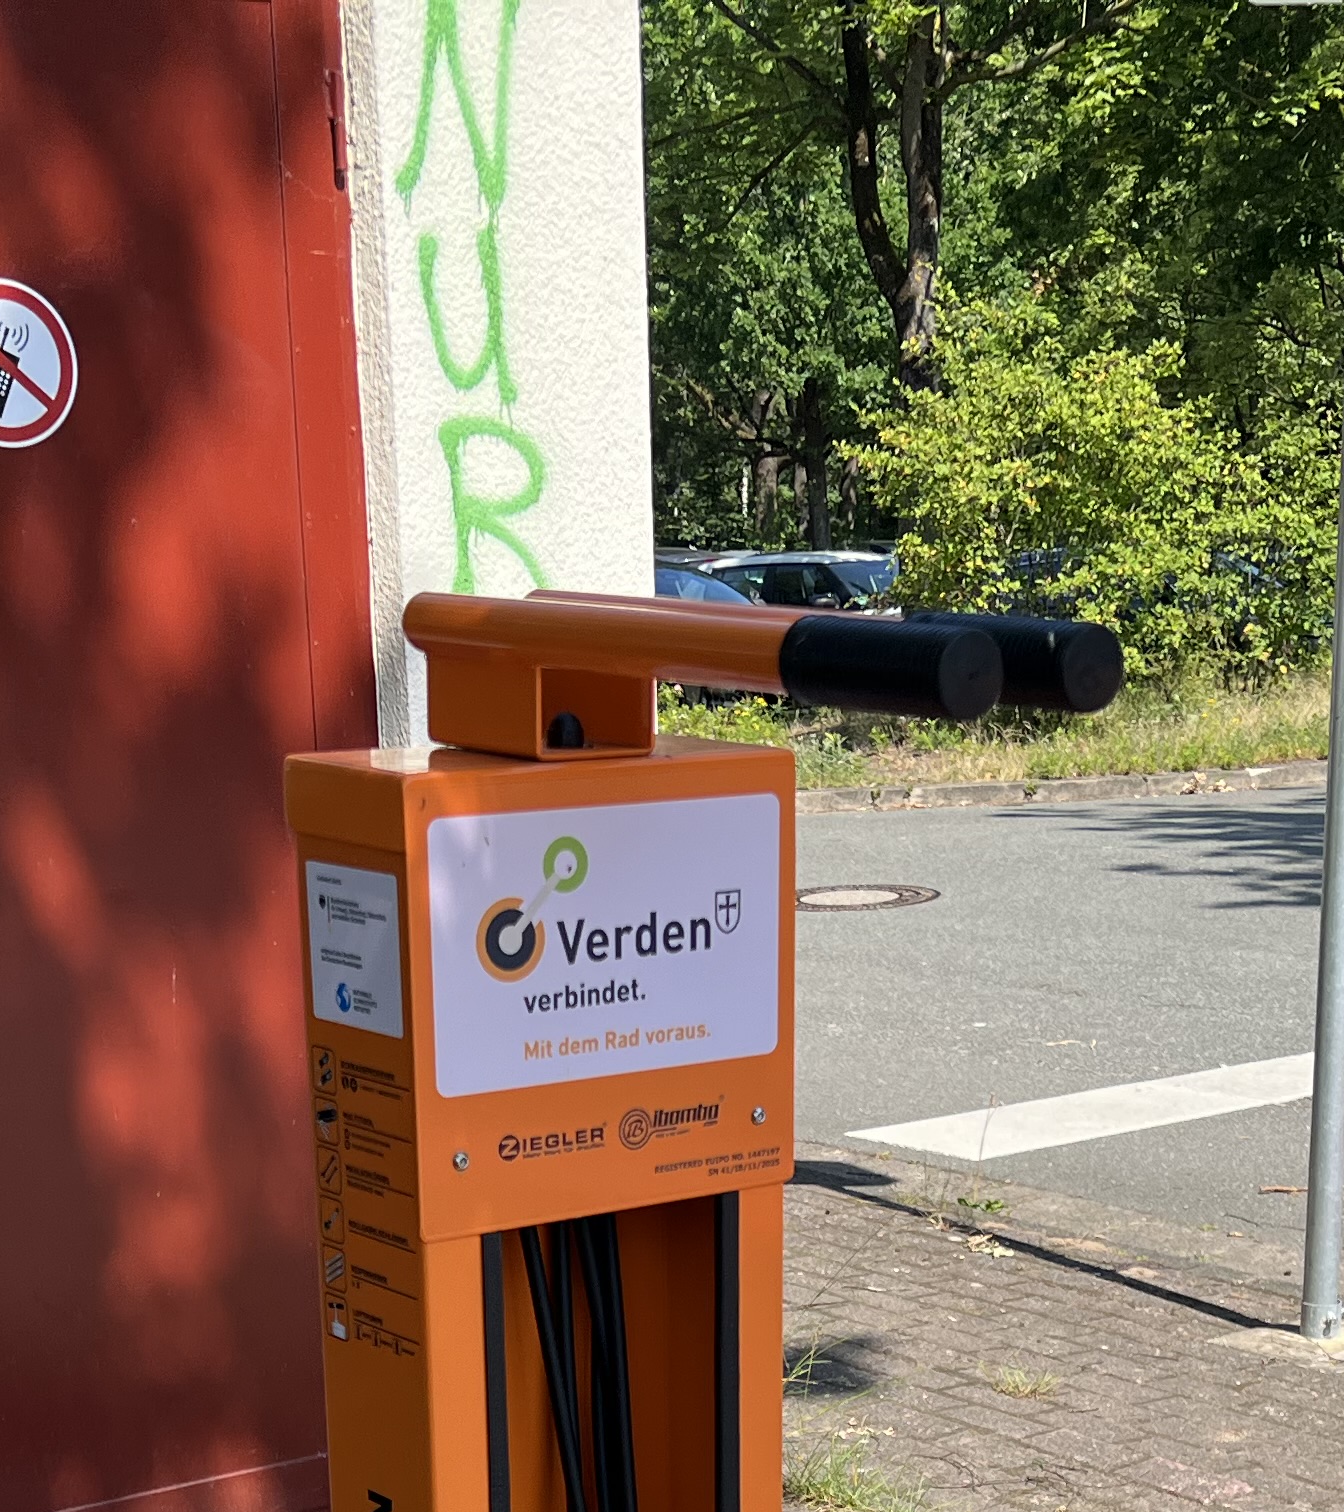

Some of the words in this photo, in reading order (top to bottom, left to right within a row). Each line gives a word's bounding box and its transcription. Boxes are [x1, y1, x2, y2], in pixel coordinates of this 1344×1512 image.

[557, 911, 712, 965] Verden
[523, 979, 646, 1014] verbindet.
[523, 1039, 553, 1061] Mit
[558, 1037, 599, 1056] dem
[605, 1028, 640, 1050] Rad
[645, 1023, 712, 1046] voraus.
[498, 1127, 605, 1162] ZIEGLER
[654, 1160, 703, 1175] REGISTERED
